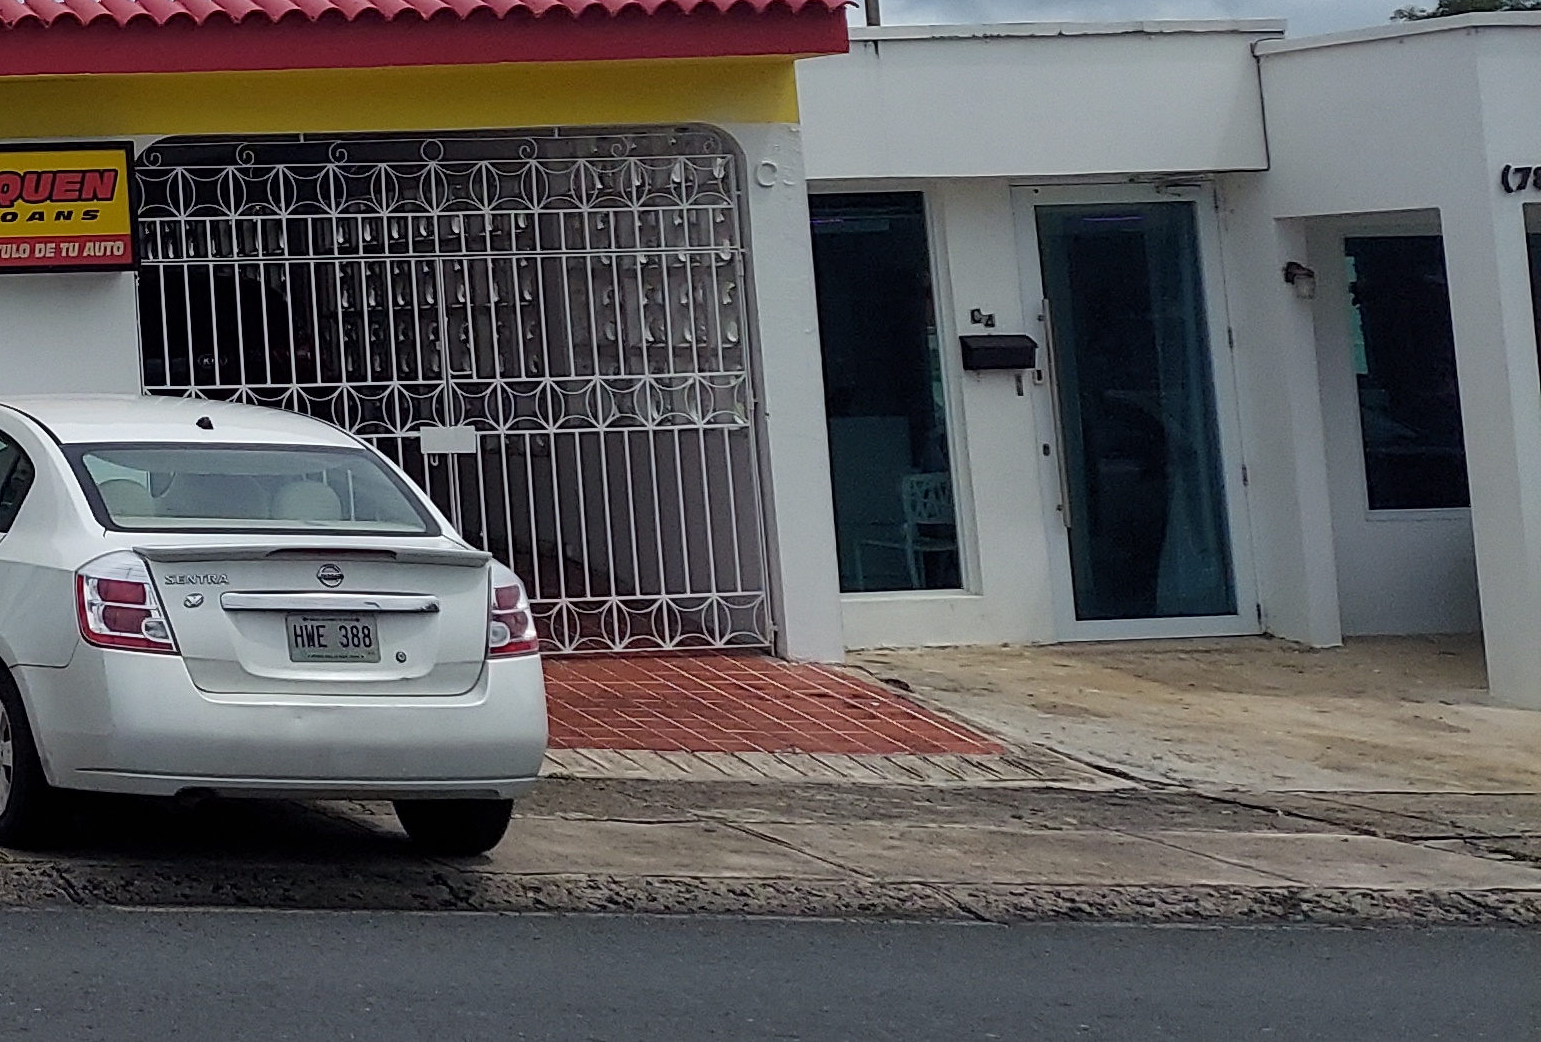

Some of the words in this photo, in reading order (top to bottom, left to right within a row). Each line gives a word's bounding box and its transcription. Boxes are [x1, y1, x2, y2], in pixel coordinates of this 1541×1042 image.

[35, 243, 55, 258] DE
[60, 242, 79, 257] TU
[83, 241, 124, 257] AUTO
[165, 574, 230, 585] SENTRA
[293, 624, 327, 648] HWE
[339, 625, 372, 648] 388
